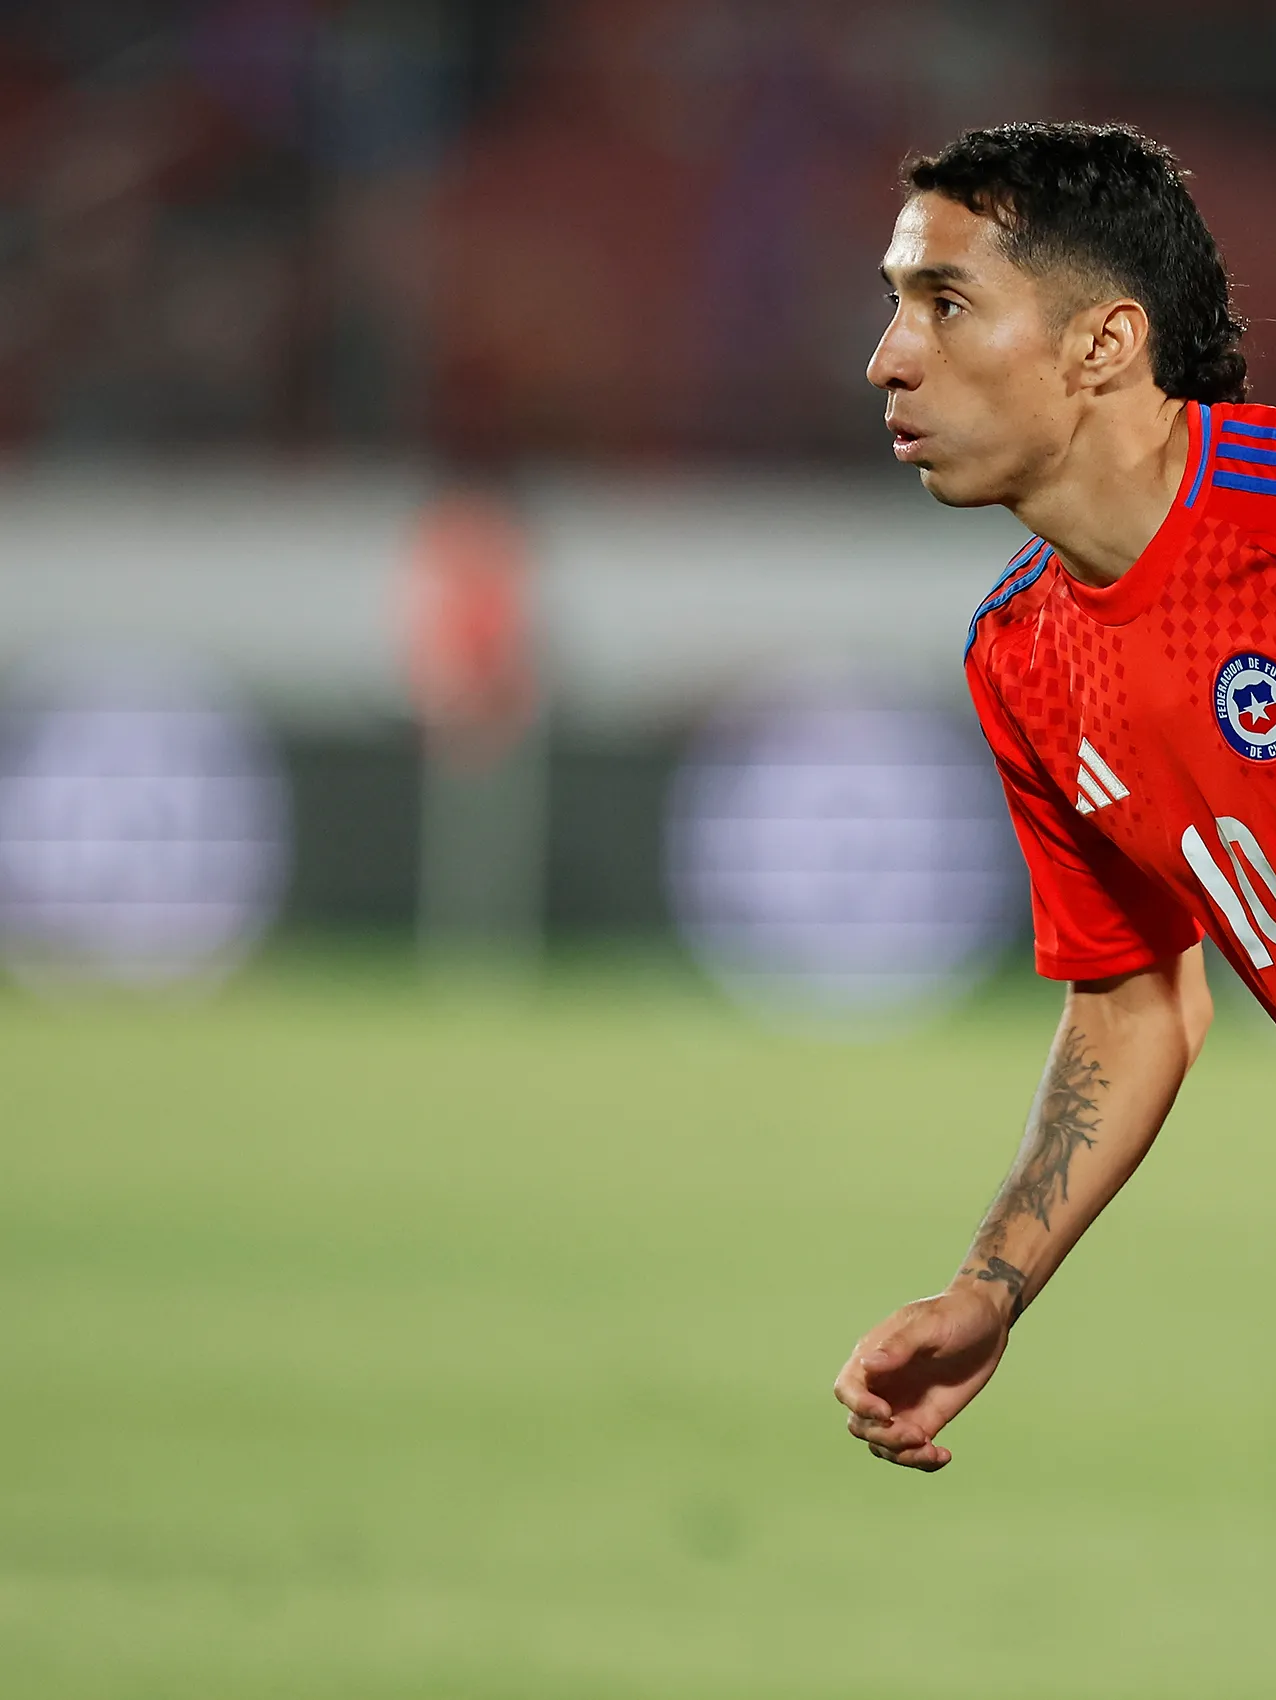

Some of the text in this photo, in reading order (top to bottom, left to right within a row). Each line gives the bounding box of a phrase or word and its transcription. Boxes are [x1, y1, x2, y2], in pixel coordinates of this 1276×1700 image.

[1217, 659, 1243, 719] FEDERACION
[1248, 657, 1260, 669] DE
[1249, 746, 1262, 758] DE
